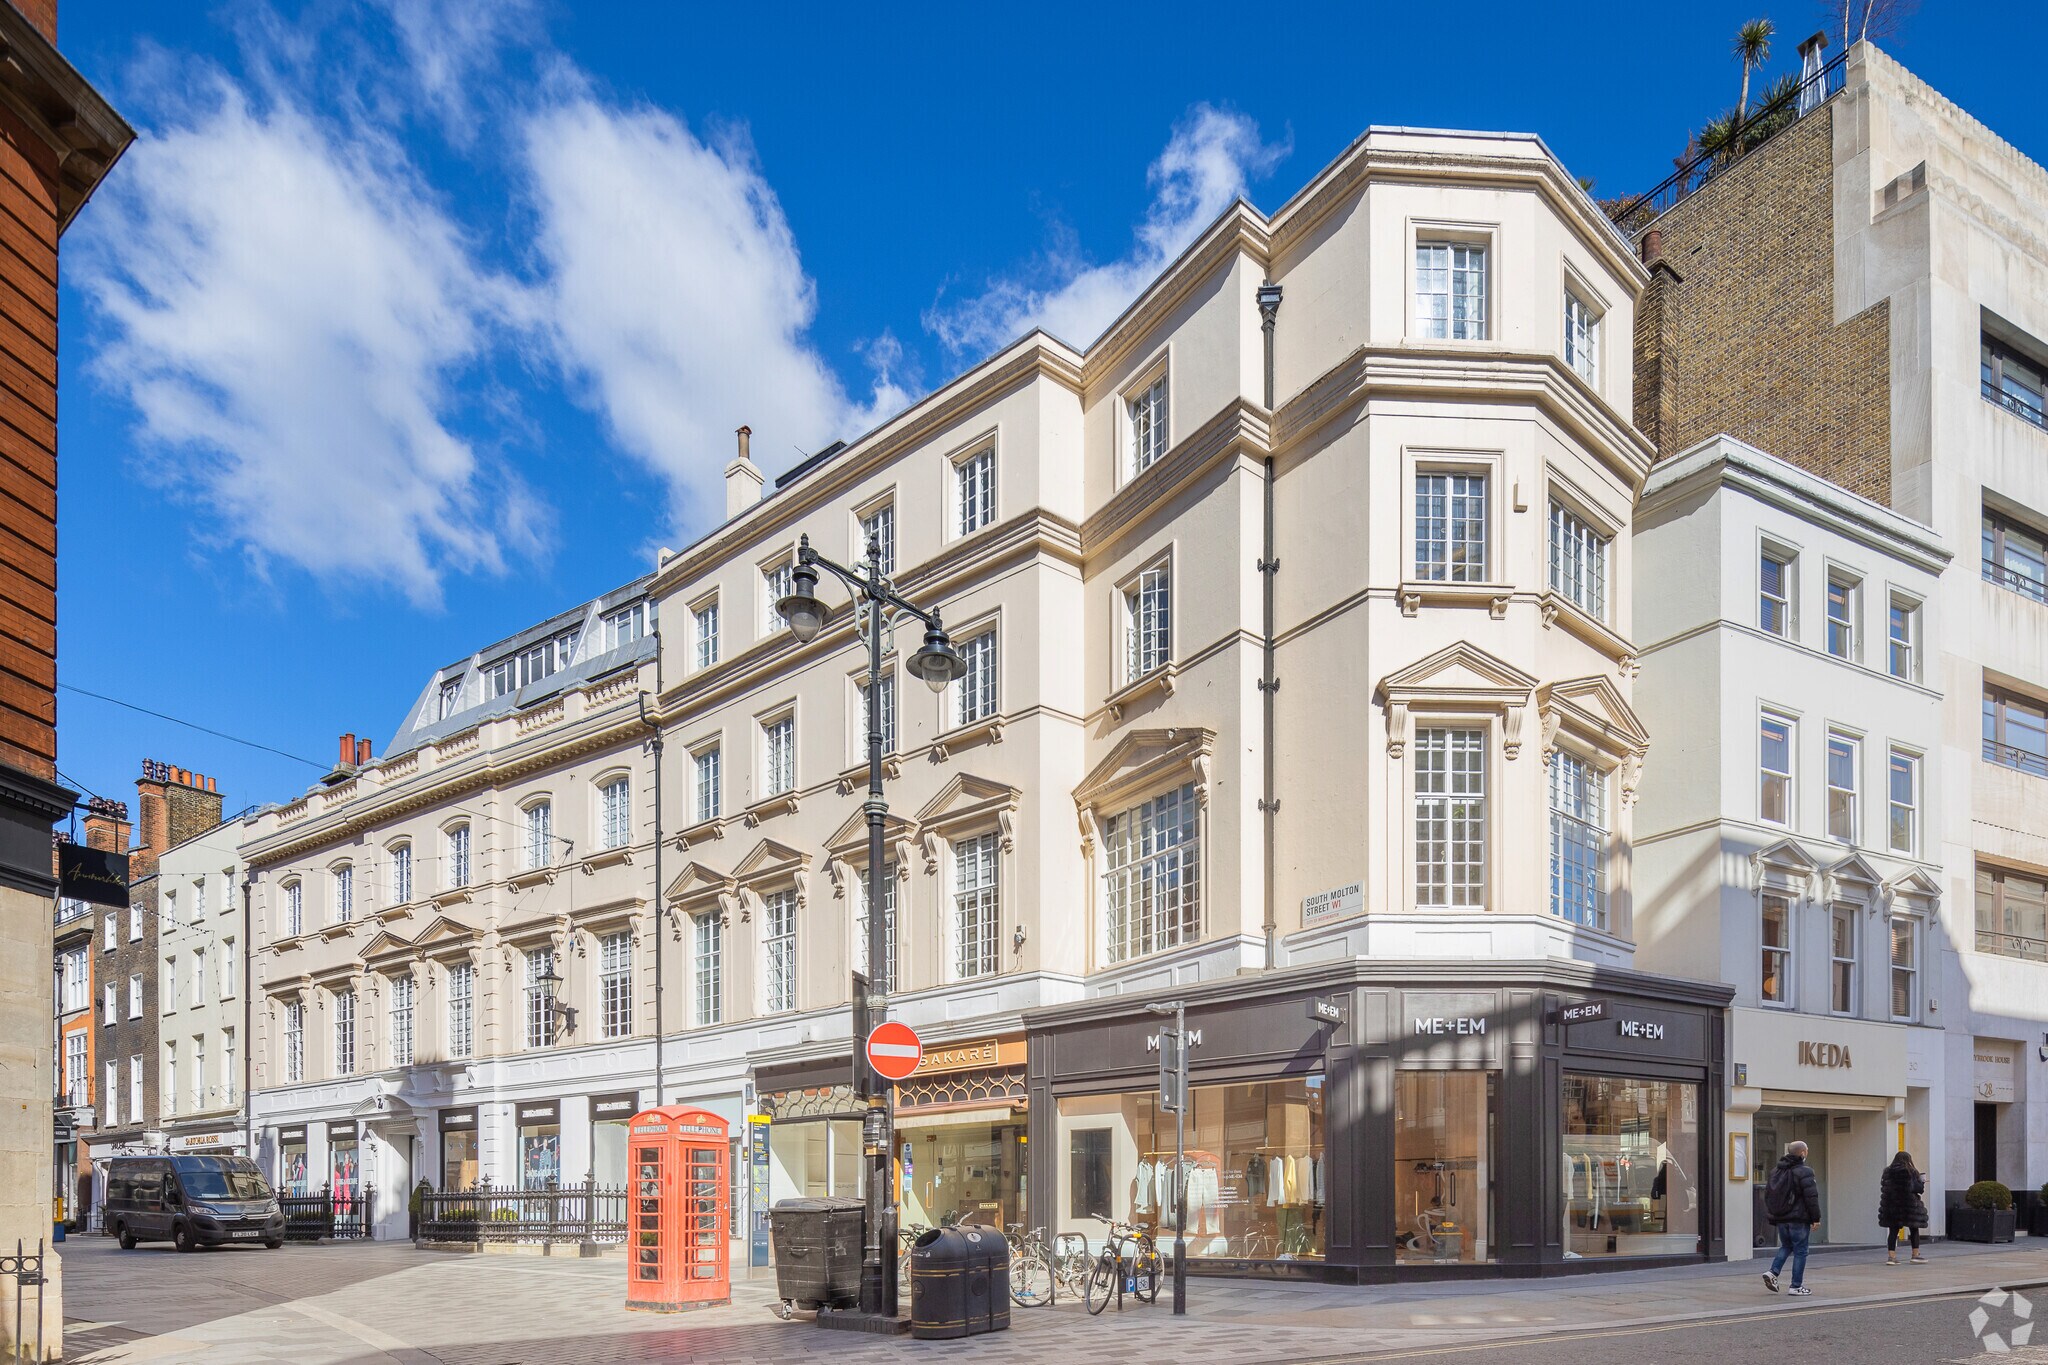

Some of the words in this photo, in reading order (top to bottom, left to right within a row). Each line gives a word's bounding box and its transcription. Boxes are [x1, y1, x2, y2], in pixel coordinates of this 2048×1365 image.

[1306, 894, 1328, 907] SOUTH
[1331, 885, 1359, 900] MOLTON
[1306, 903, 1330, 916] STREET
[1332, 900, 1341, 909] W1
[1318, 1002, 1339, 1018] ME+EM
[1563, 1005, 1601, 1020] ME+EM
[1415, 1018, 1485, 1035] ME+EM
[1620, 1020, 1664, 1040] ME+EM
[920, 1044, 993, 1066] SAKARÉ
[1798, 1041, 1852, 1068] IKEDA
[1974, 1054, 1994, 1063] YBROOK
[1984, 1083, 1993, 1095] 28
[635, 1126, 667, 1134] TELEPHONE
[682, 1126, 720, 1135] TELEPHONE
[1128, 1279, 1134, 1289] P
